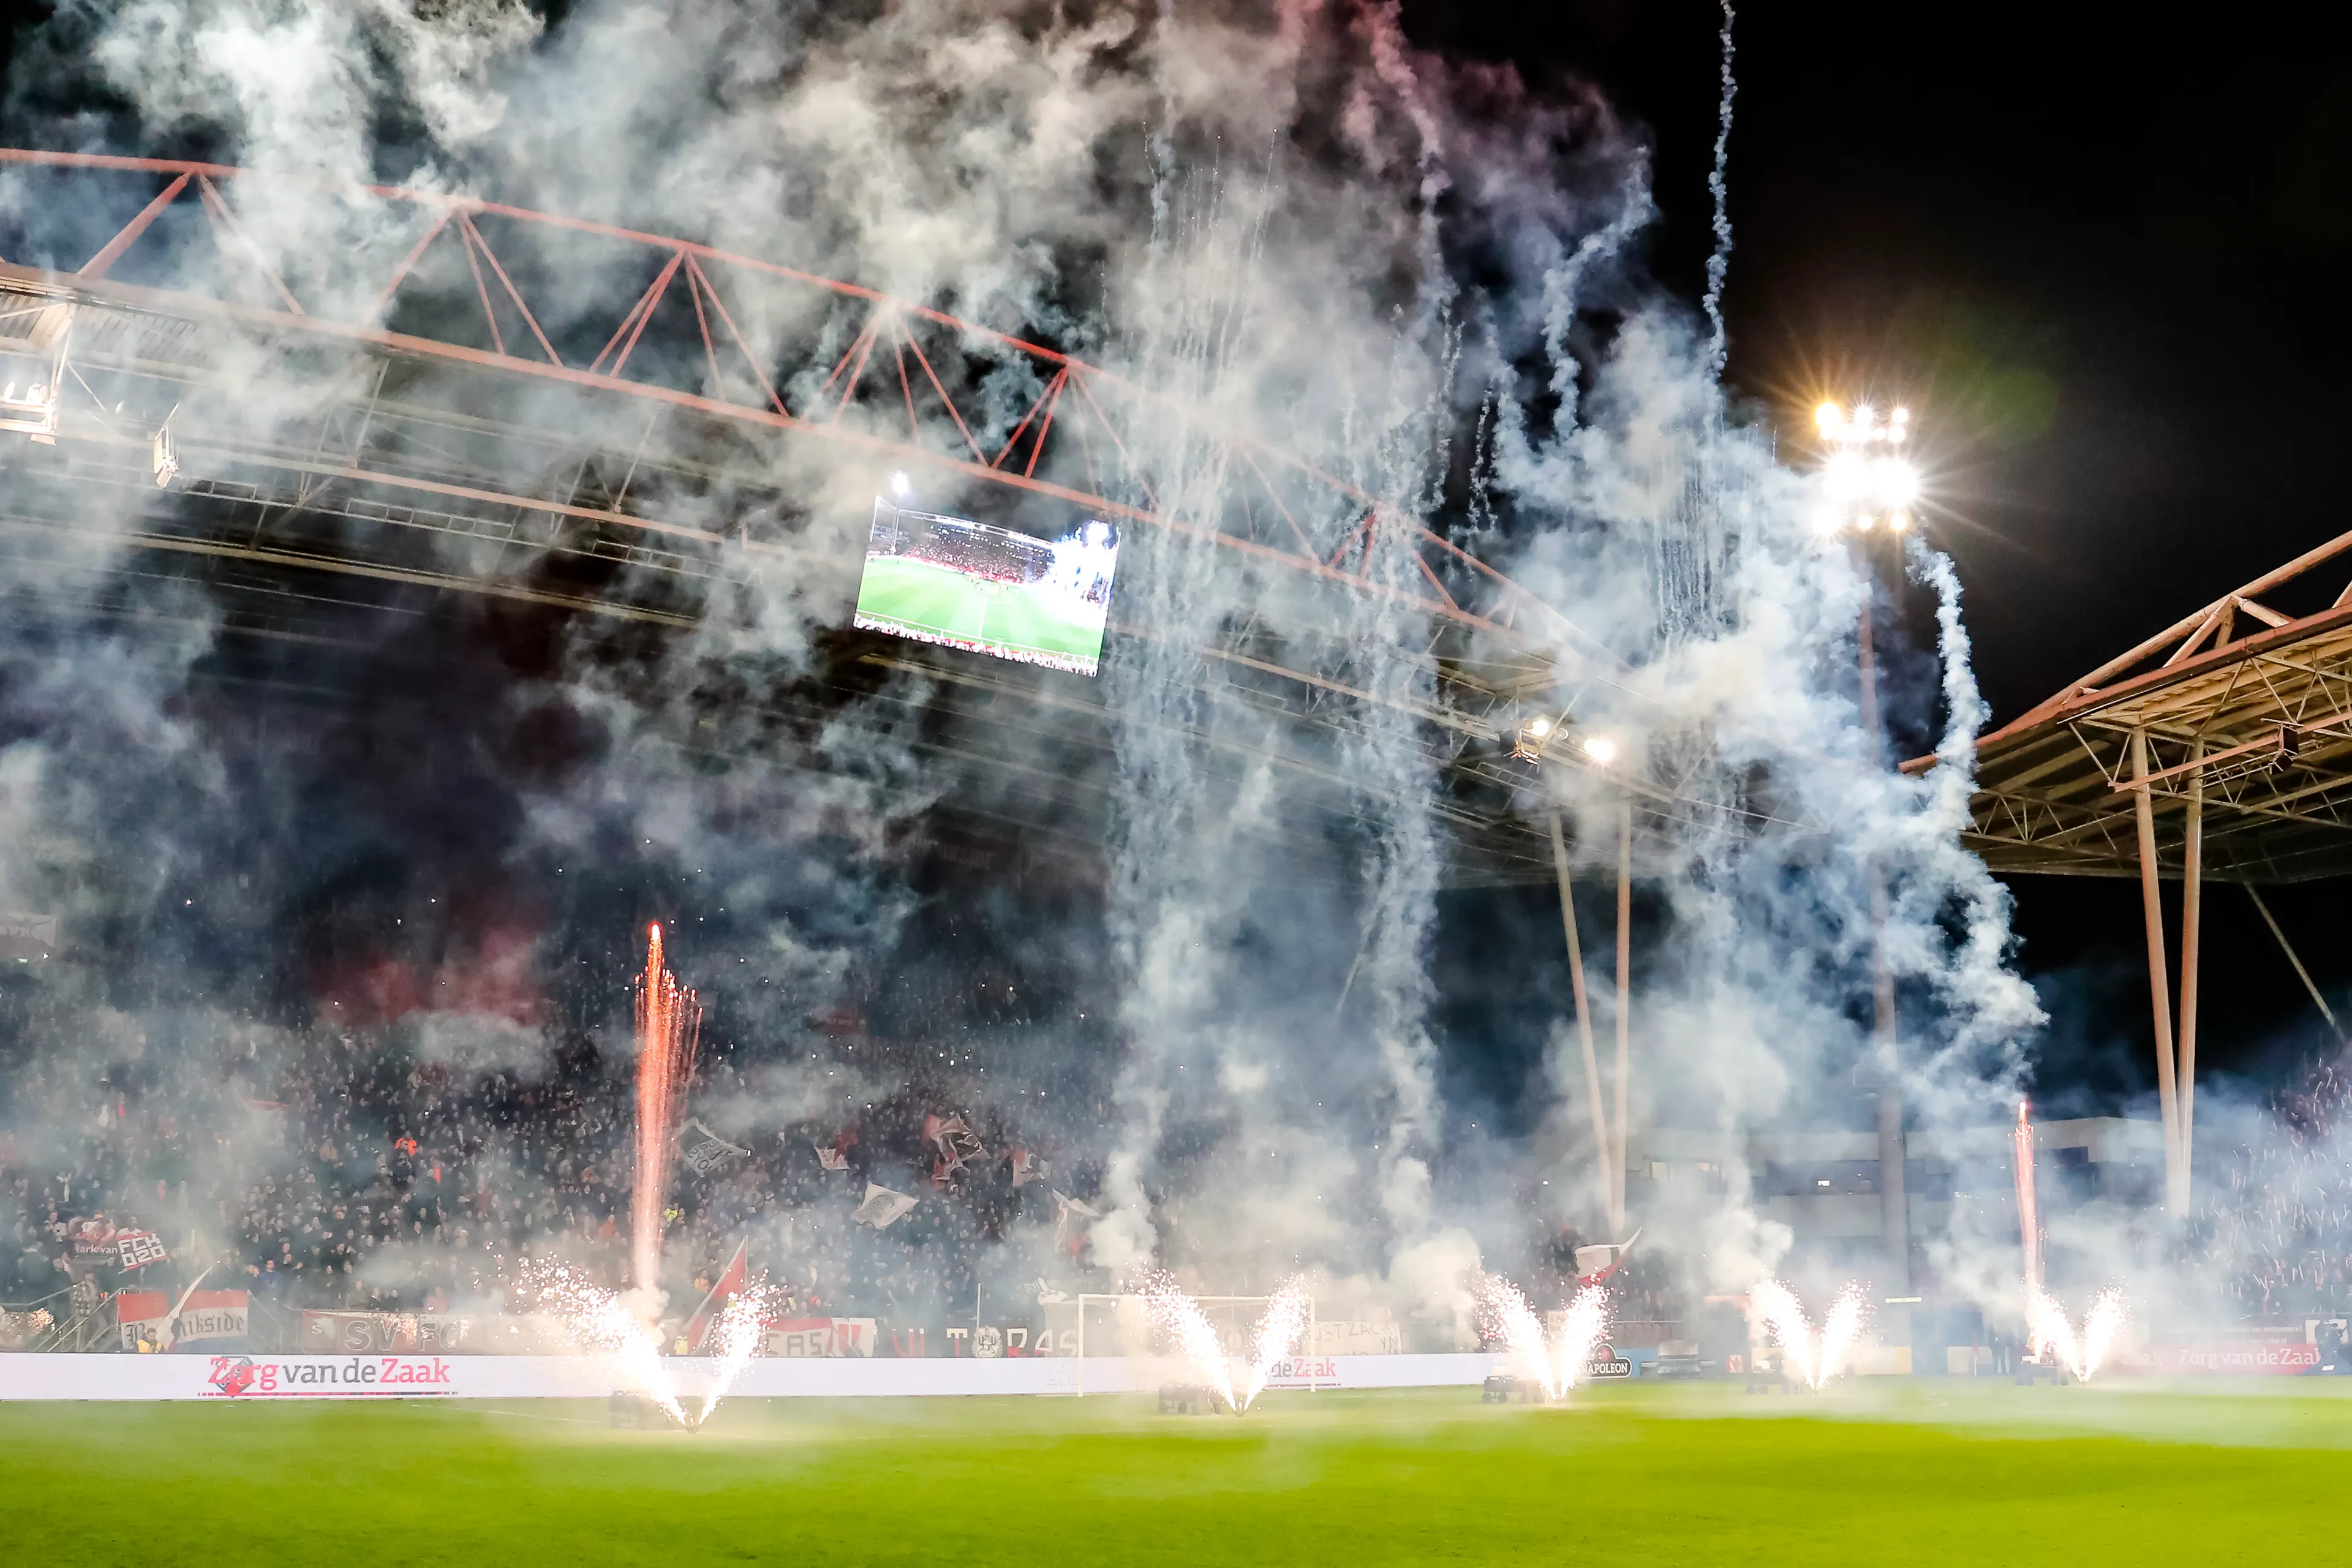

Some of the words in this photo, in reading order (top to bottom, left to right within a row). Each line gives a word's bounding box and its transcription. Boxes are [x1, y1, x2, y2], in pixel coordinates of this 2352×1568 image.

[121, 1244, 167, 1267] 020
[1272, 1360, 1292, 1378] de
[1294, 1357, 1336, 1377] Zaak
[2179, 1349, 2218, 1370] Zorg
[2220, 1352, 2253, 1365] van
[2256, 1348, 2278, 1365] de
[208, 1357, 279, 1390] Zorg
[283, 1364, 337, 1383] van
[343, 1357, 376, 1383] de
[380, 1357, 450, 1383] Zaak
